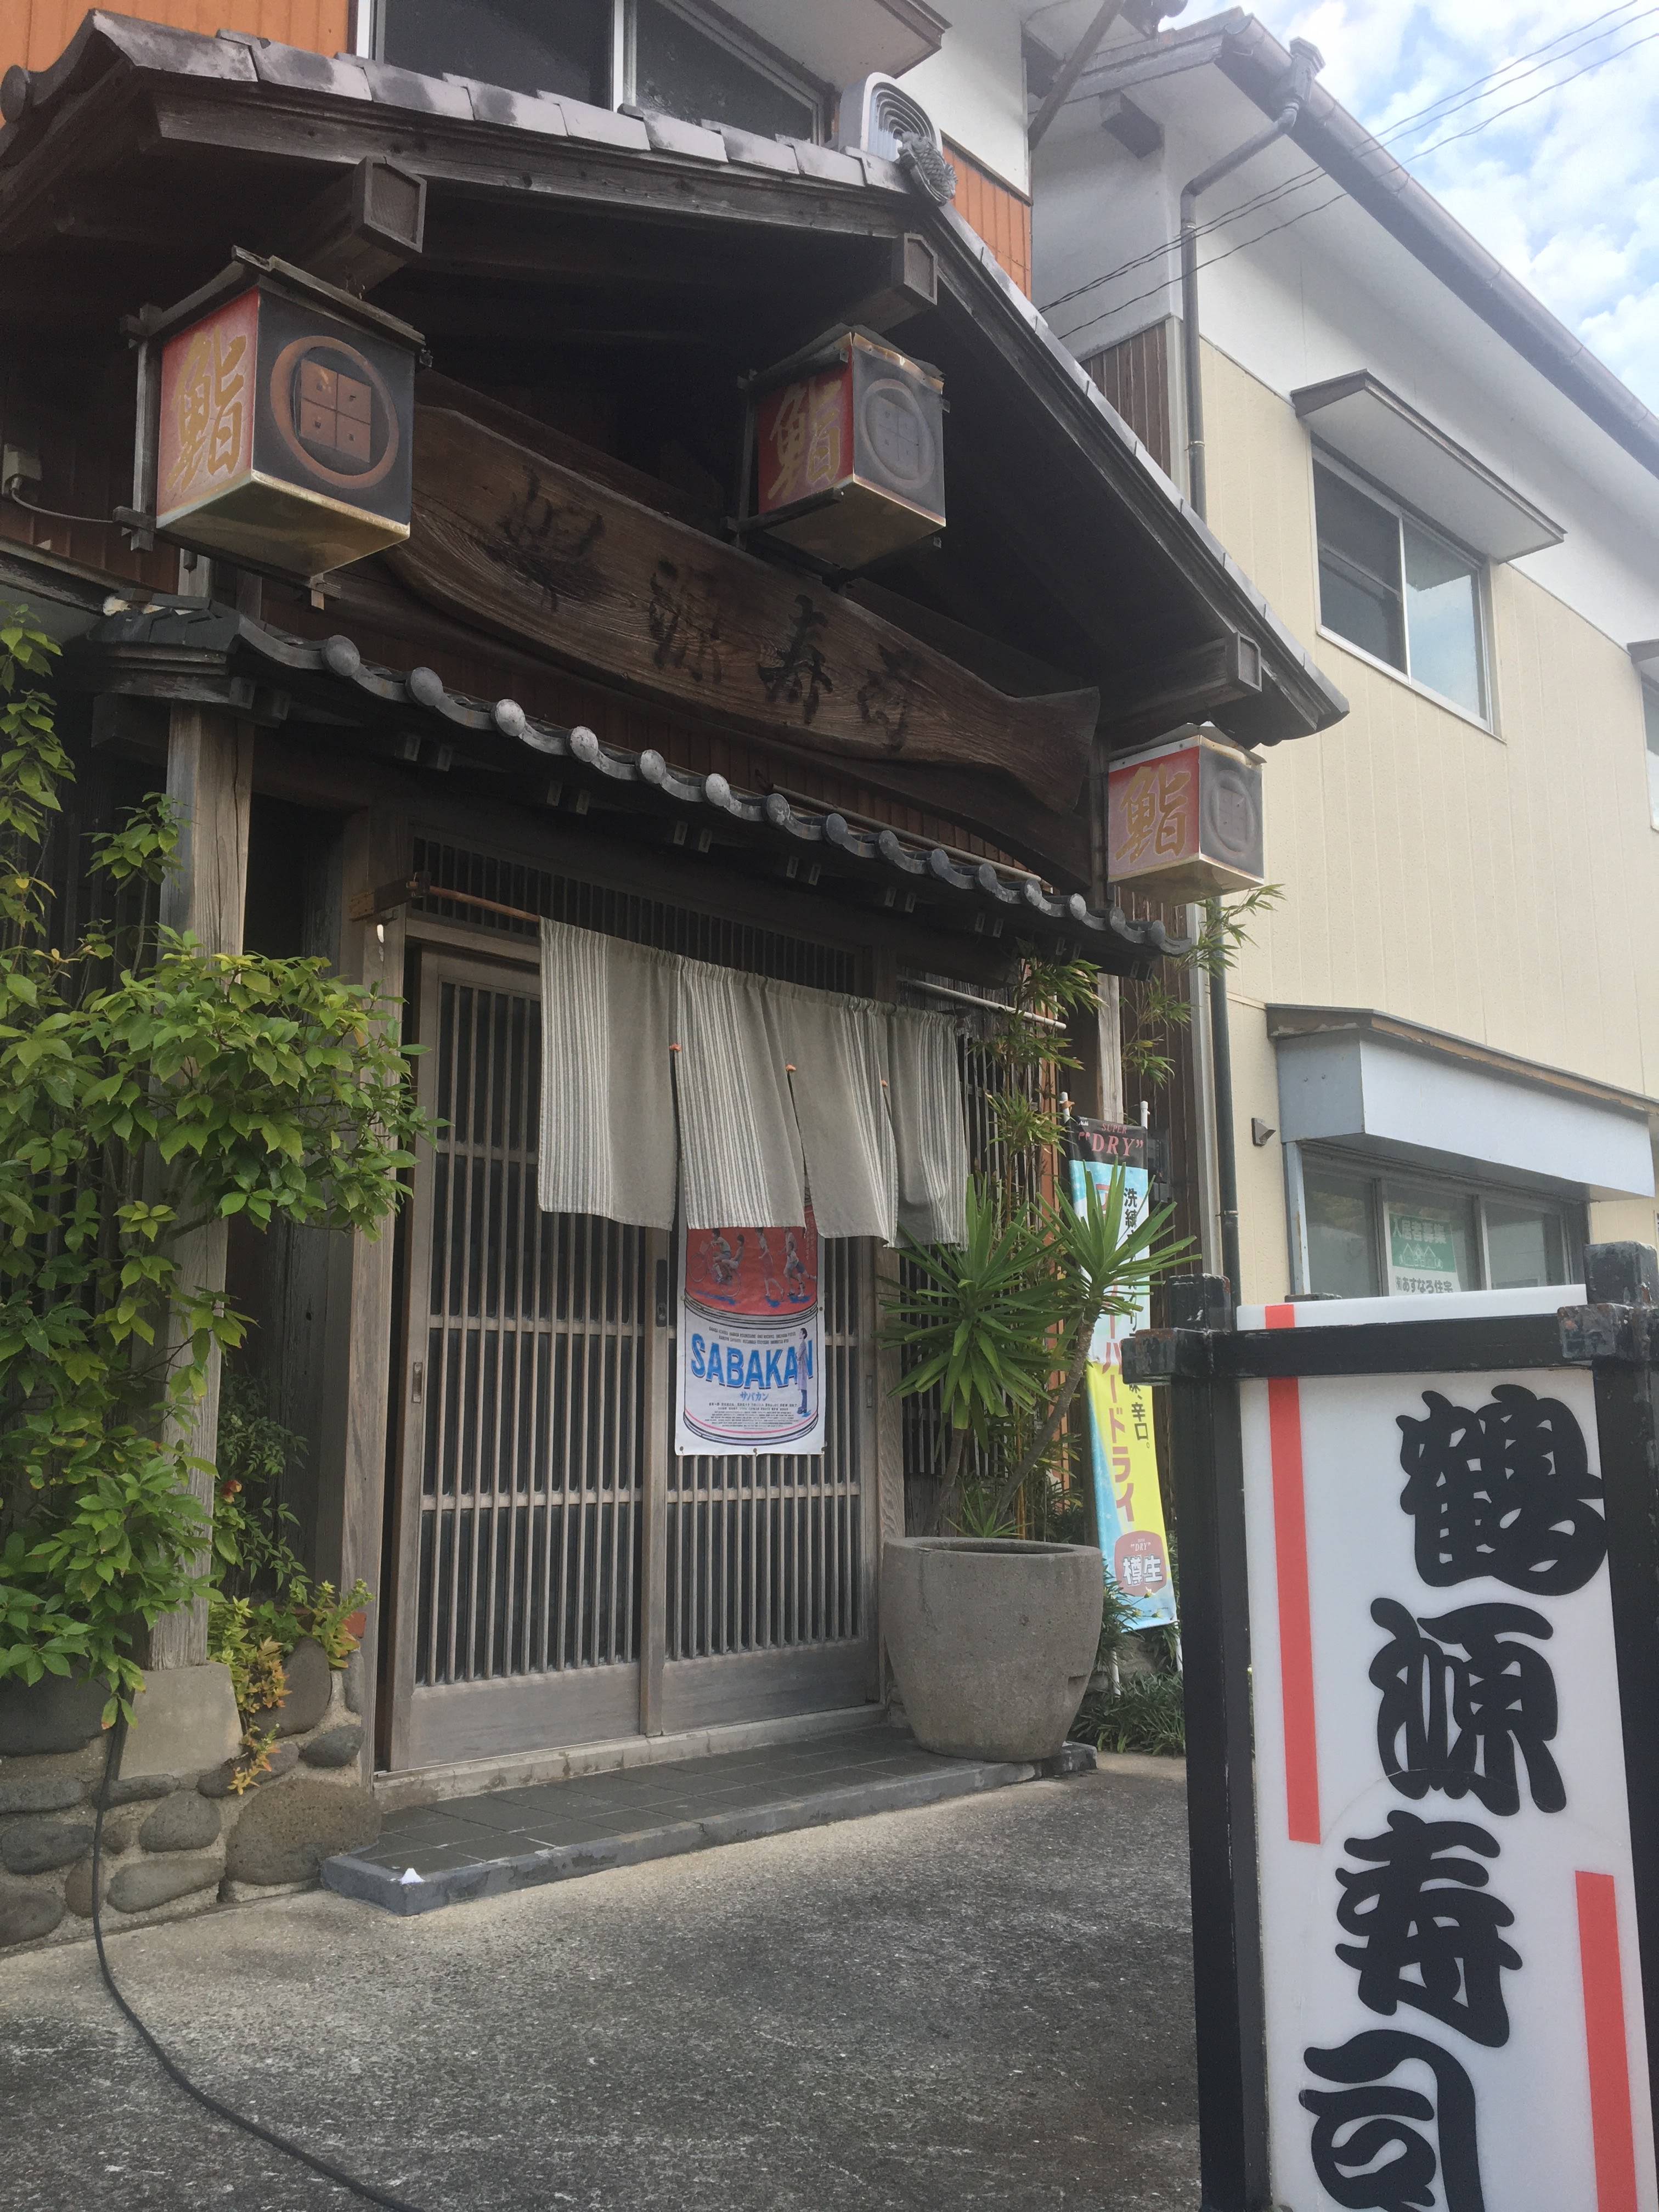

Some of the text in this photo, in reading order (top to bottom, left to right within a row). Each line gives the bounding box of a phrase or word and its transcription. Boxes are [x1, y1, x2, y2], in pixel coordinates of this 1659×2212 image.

[167, 324, 247, 493] 鮨
[768, 376, 842, 500] 鮨
[1115, 763, 1190, 864] 鮨
[1101, 1123, 1127, 1135] SUPER
[740, 1391, 769, 1401] サバカン
[1122, 1554, 1163, 1586] 樽生
